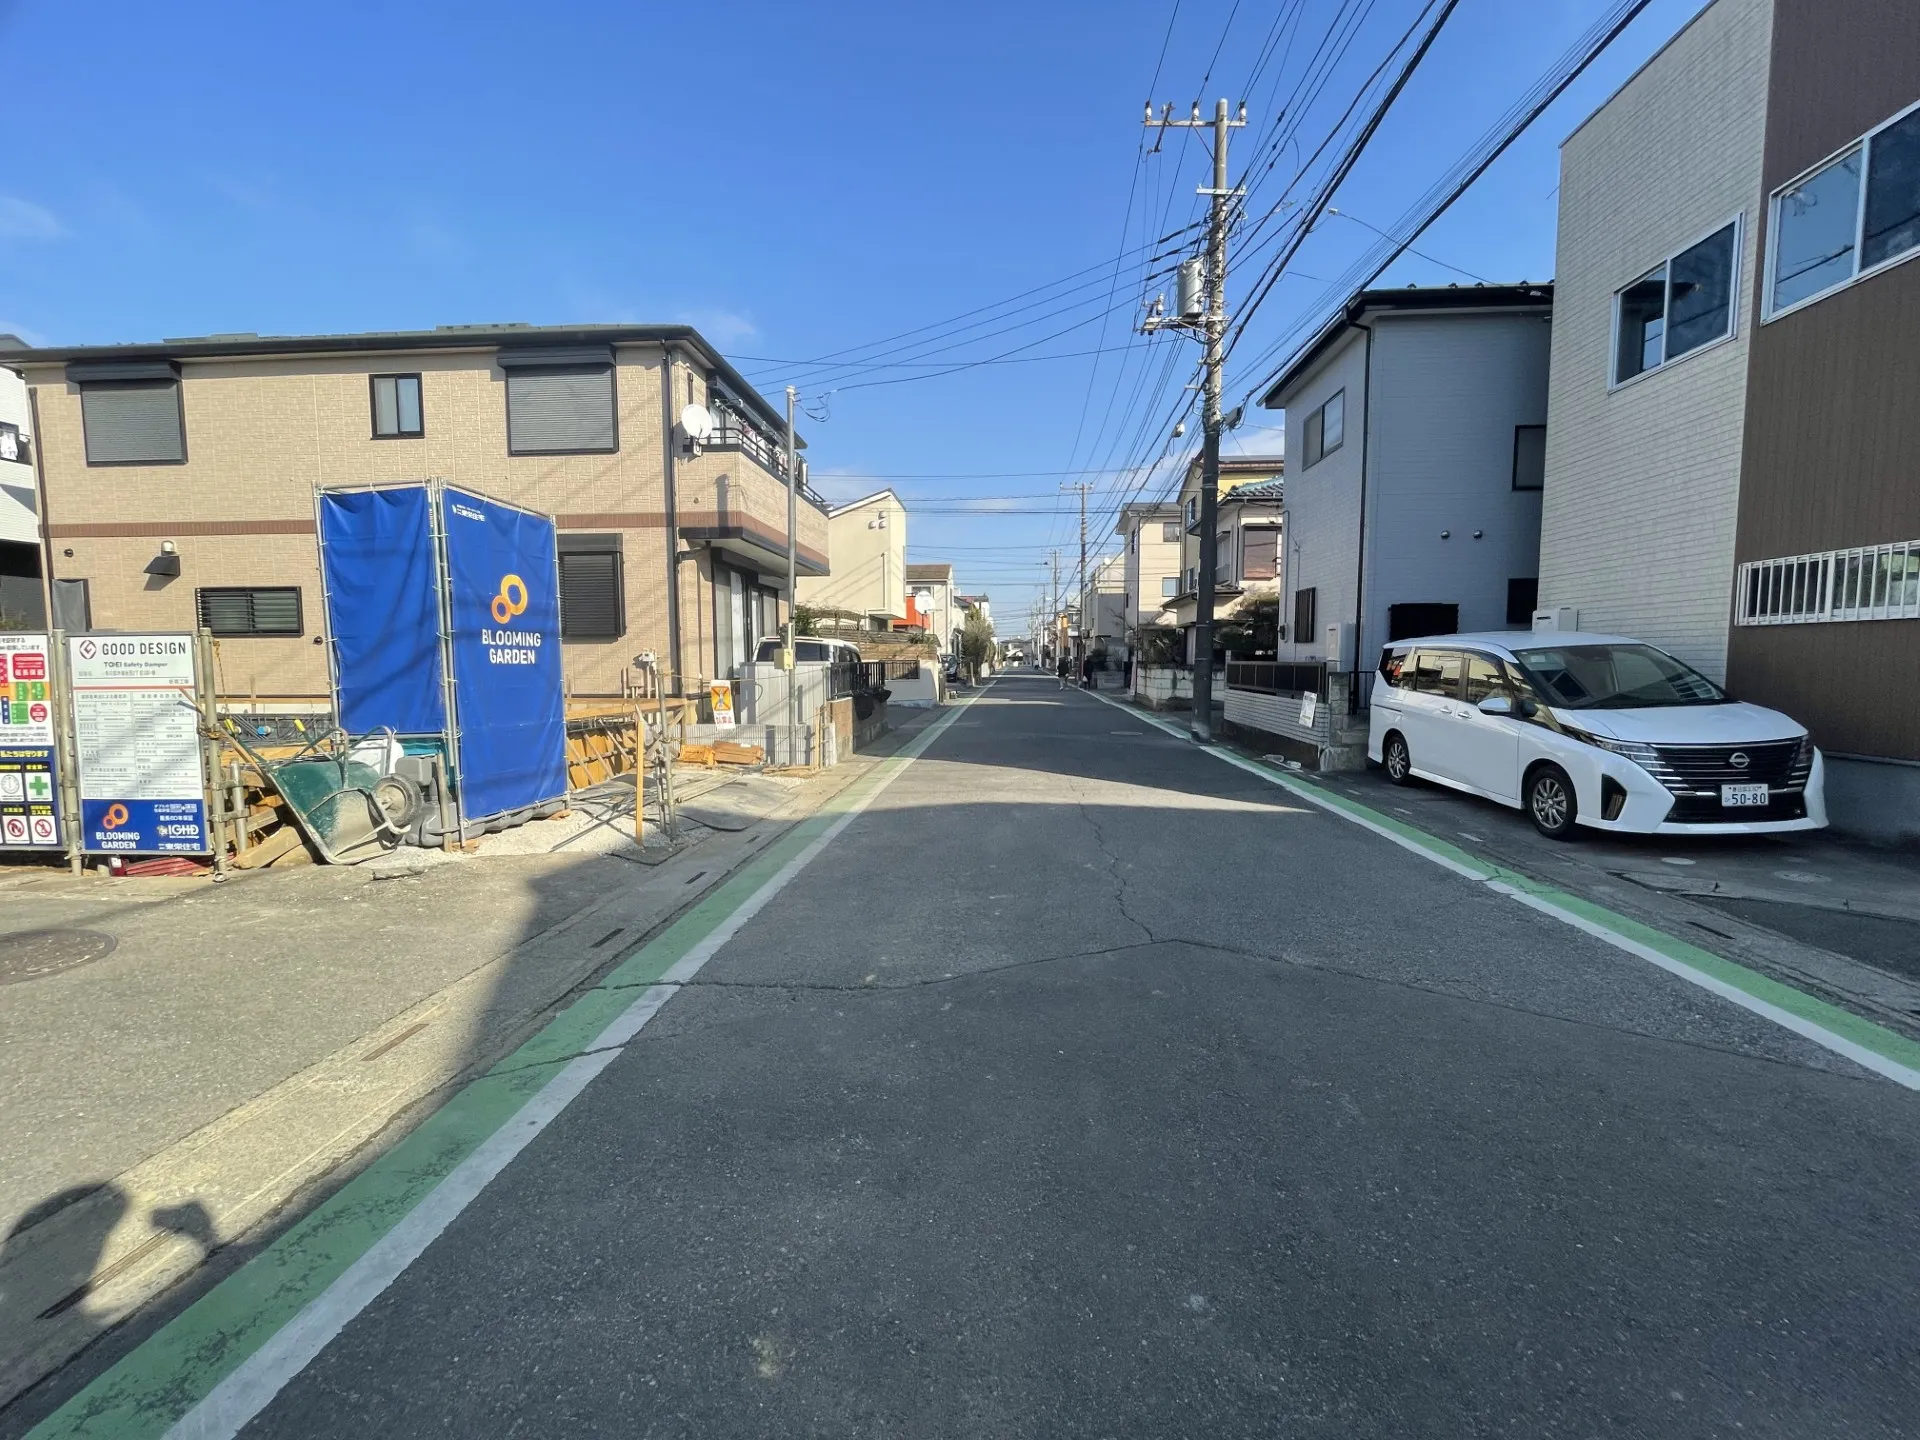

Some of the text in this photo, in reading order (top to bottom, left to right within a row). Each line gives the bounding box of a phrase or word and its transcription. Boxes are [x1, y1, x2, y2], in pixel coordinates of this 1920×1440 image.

[482, 629, 541, 647] BLOOMING
[102, 642, 186, 655] GOOD DESIGN
[489, 648, 535, 664] GARDEN
[1732, 793, 1766, 805] 50-80
[95, 832, 140, 840] BLOOMING
[101, 841, 136, 849] GARDEN
